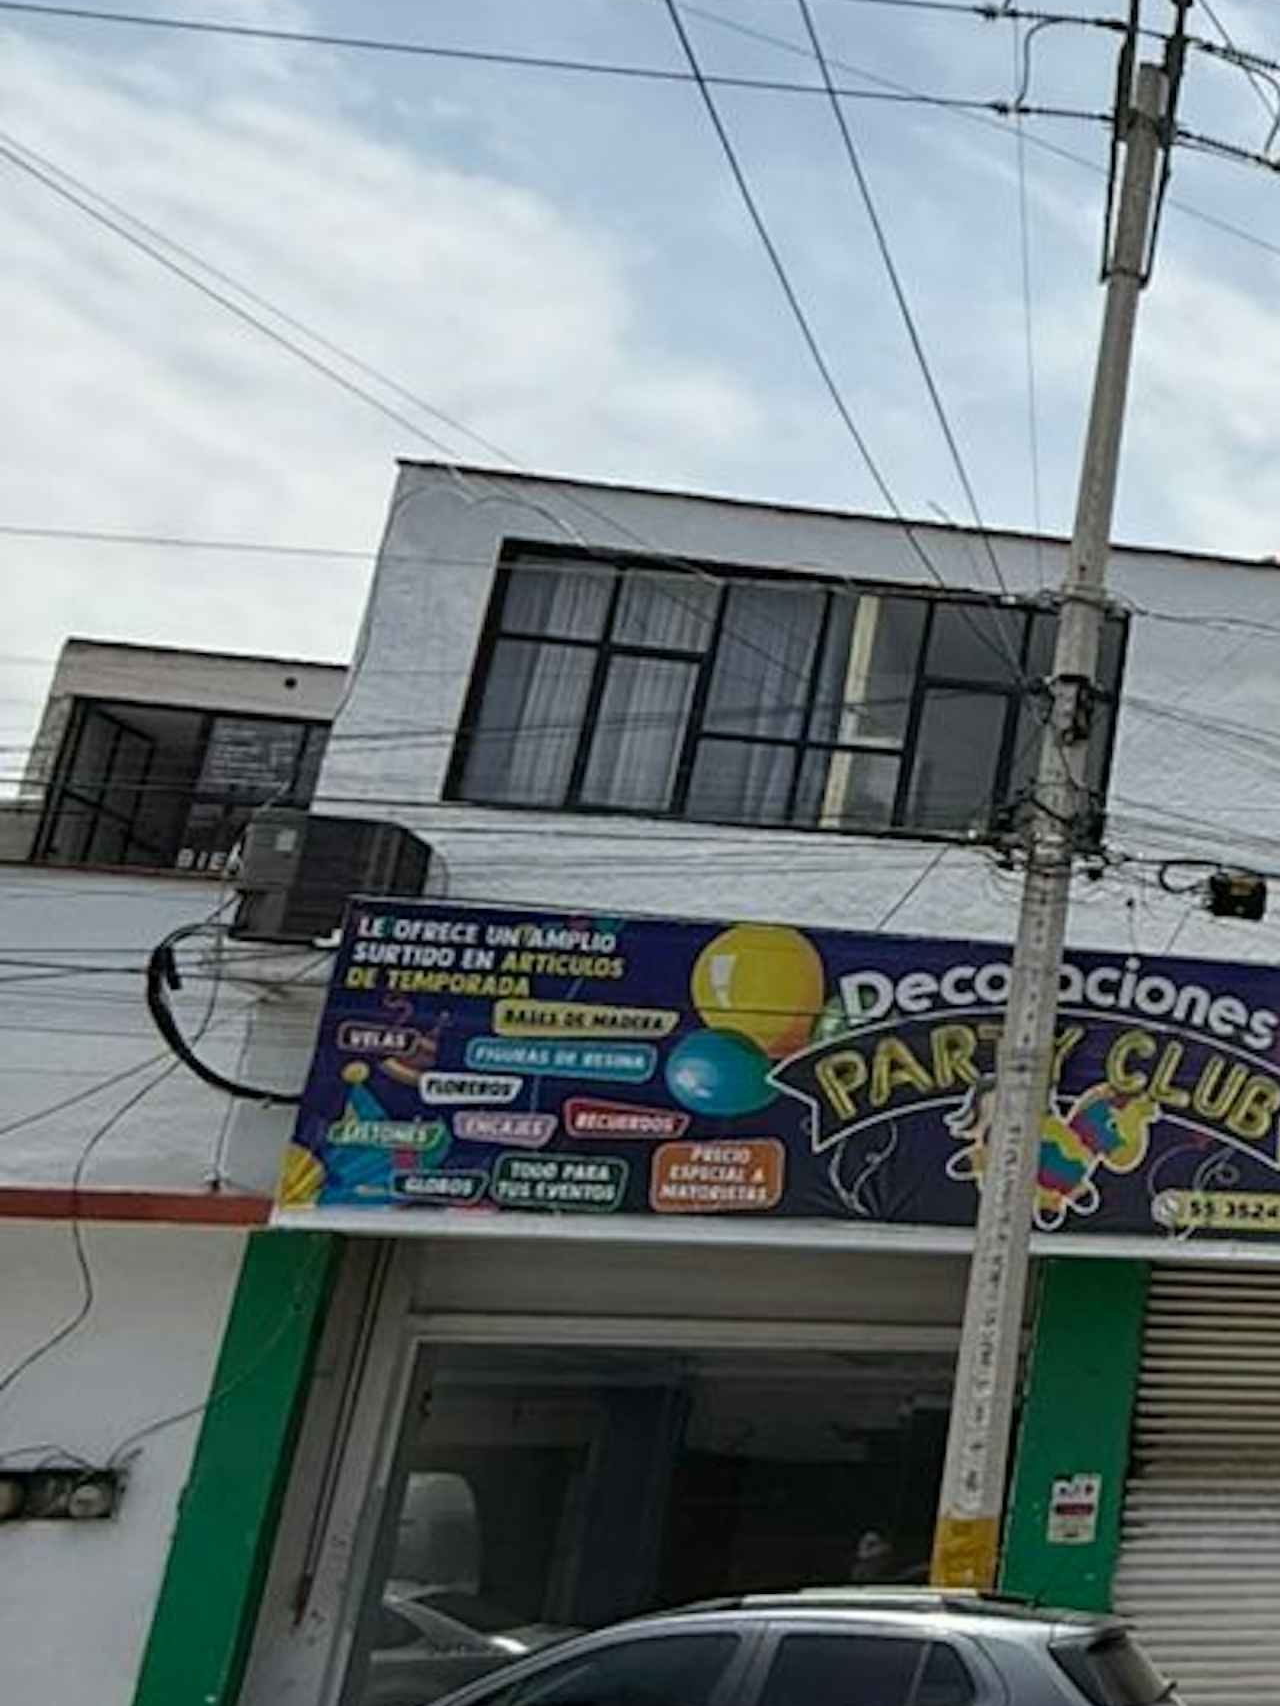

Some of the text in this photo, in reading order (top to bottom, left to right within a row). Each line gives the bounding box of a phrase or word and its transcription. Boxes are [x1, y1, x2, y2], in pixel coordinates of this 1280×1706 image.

[357, 916, 617, 953] LE OFRECE UN AMPLIO
[352, 941, 456, 966] SURTIDO
[461, 949, 495, 970] EN
[345, 966, 531, 998] DE TEMPORADA
[839, 957, 1280, 1050] Decoaciones
[562, 1011, 586, 1028] DE
[590, 1012, 665, 1031] MADERA
[350, 1028, 405, 1050] VELAS
[474, 1047, 548, 1065] FIGURAS
[554, 1052, 578, 1067] DE
[426, 1079, 513, 1097] FLOREROS
[575, 1113, 675, 1134] RECUERDOS
[690, 1146, 751, 1164] PRECIO
[510, 1161, 611, 1182] TODO PARA
[668, 1163, 766, 1184] ESPECIAL A
[403, 1175, 474, 1197] GLOBOS
[499, 1180, 616, 1201] TUS EVENTOS
[659, 1184, 768, 1202] MAYORISTAS
[1191, 1200, 1214, 1219] 55
[1225, 1201, 1279, 1221] 3524
